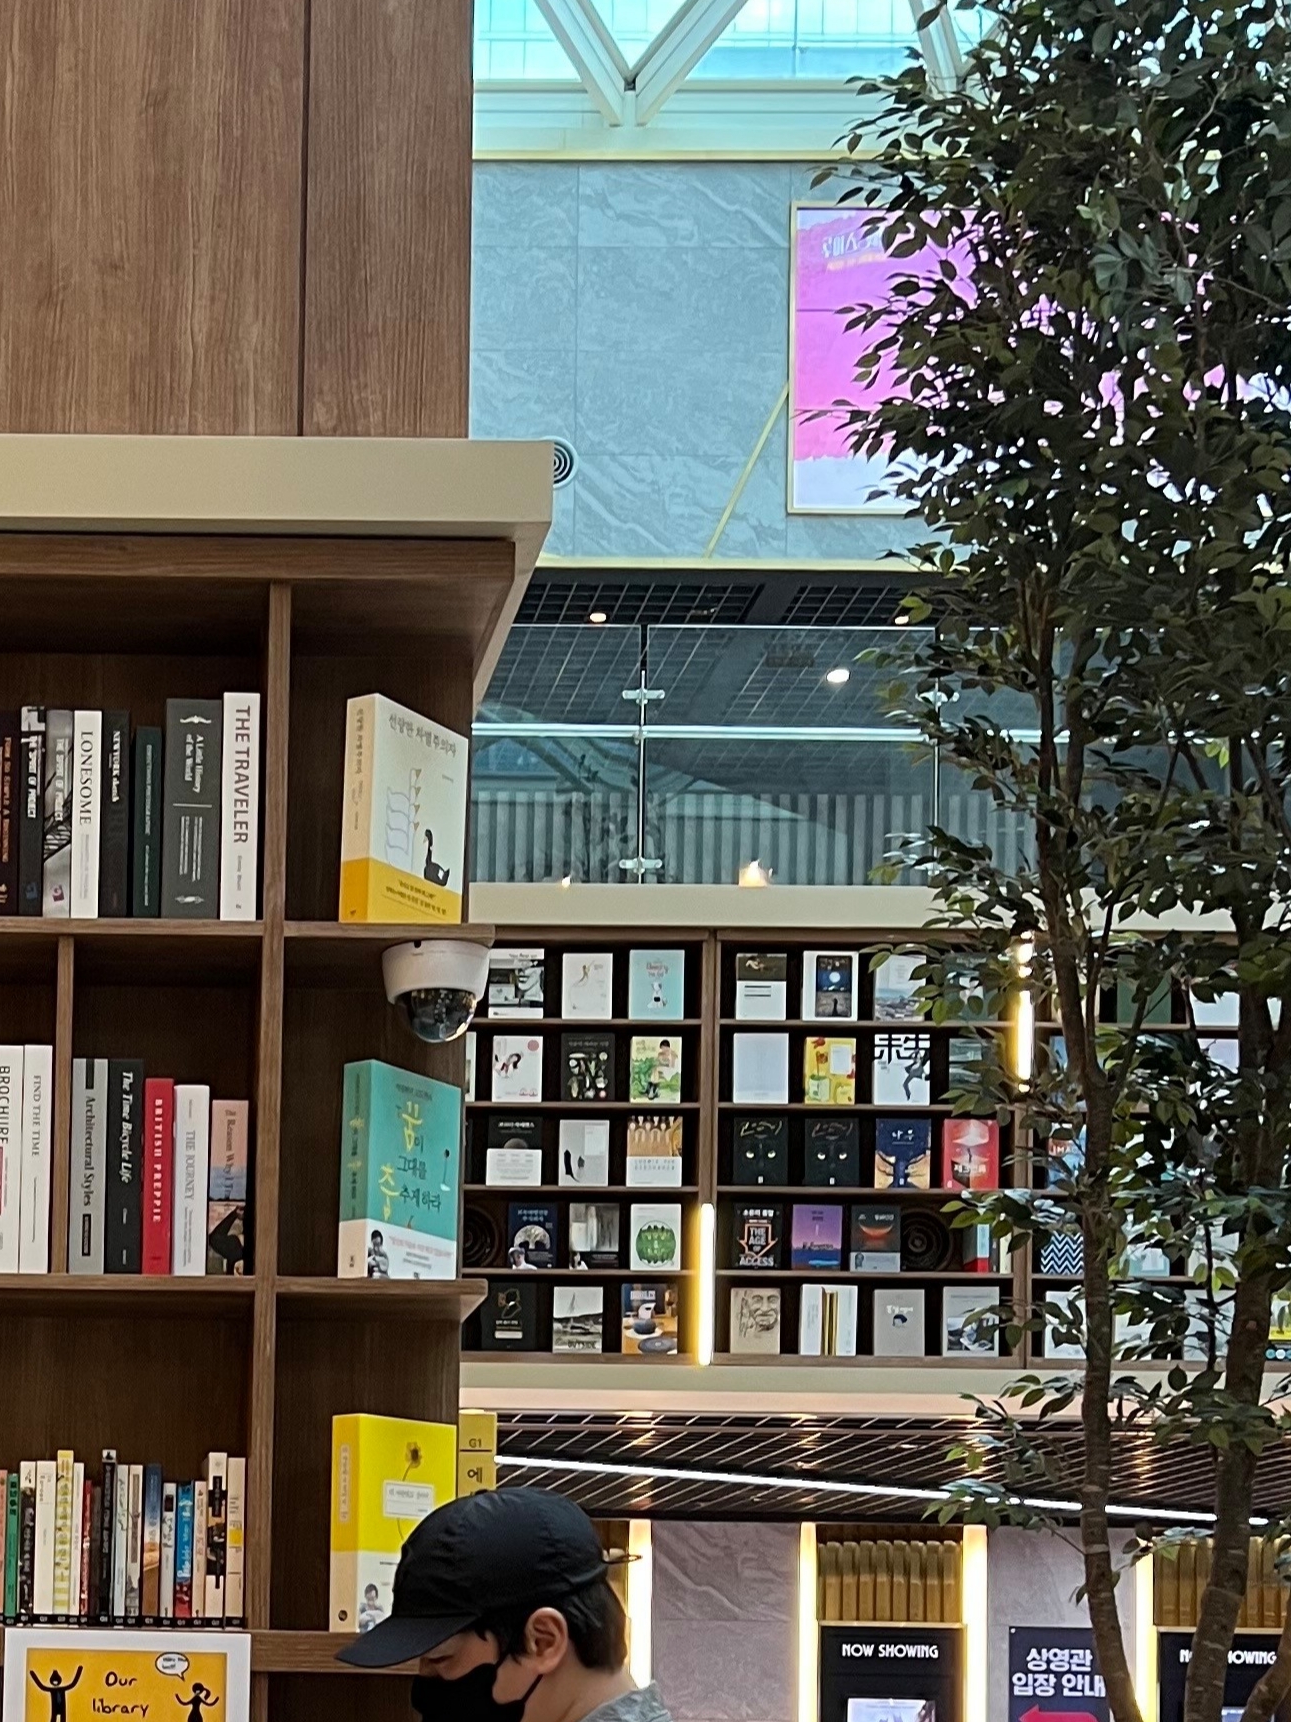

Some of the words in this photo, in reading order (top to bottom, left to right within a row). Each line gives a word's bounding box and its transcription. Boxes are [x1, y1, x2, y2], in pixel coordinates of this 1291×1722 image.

[235, 705, 251, 743] THE
[388, 712, 414, 736] 선량한
[79, 731, 94, 826] LONESOME
[233, 747, 250, 844] TRAVELER
[33, 1075, 42, 1102] FIND
[122, 1071, 133, 1091] The
[32, 1105, 41, 1127] THE
[122, 1093, 133, 1120] Time
[83, 1095, 96, 1170] Architectural
[119, 1121, 132, 1160] Bicycle
[153, 1098, 163, 1158] BRITISH
[185, 1130, 196, 1151] THE
[226, 1119, 237, 1151] Reason
[31, 1130, 40, 1157] TIME
[118, 1162, 132, 1183] Life
[184, 1154, 195, 1200] JOURNEY
[81, 1173, 95, 1206] Styles
[152, 1164, 162, 1223] PREPPIE
[469, 1437, 482, 1449] G1
[842, 1644, 875, 1657] NOW
[878, 1644, 939, 1659] SHOWING
[1026, 1648, 1093, 1672] 상영관
[105, 1671, 137, 1687] Our
[1012, 1672, 1057, 1696] 입장
[1061, 1674, 1106, 1697] 안내
[92, 1698, 149, 1717] library
